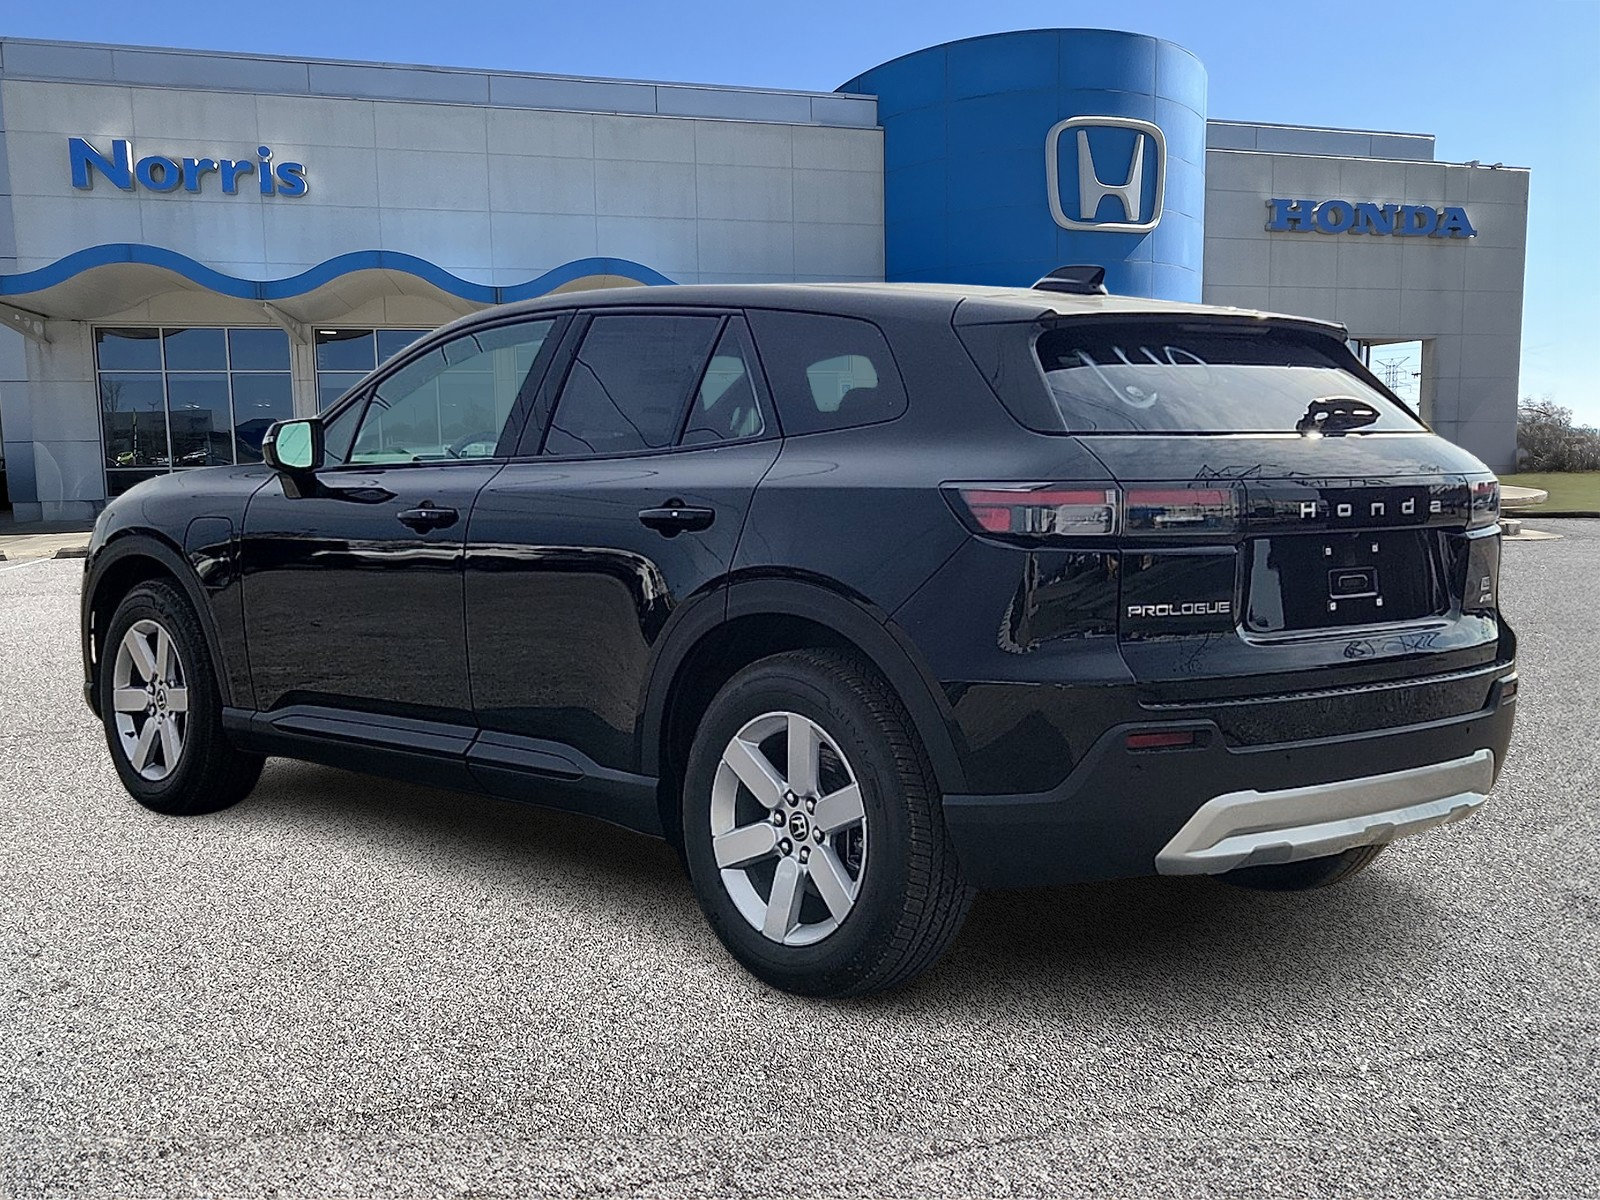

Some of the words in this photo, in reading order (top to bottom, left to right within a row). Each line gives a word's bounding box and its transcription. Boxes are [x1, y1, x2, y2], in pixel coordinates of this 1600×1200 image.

[68, 137, 309, 197] Norris
[1266, 198, 1477, 239] HONDA
[1300, 497, 1442, 519] Honda
[1127, 601, 1231, 617] PROLOGUE
